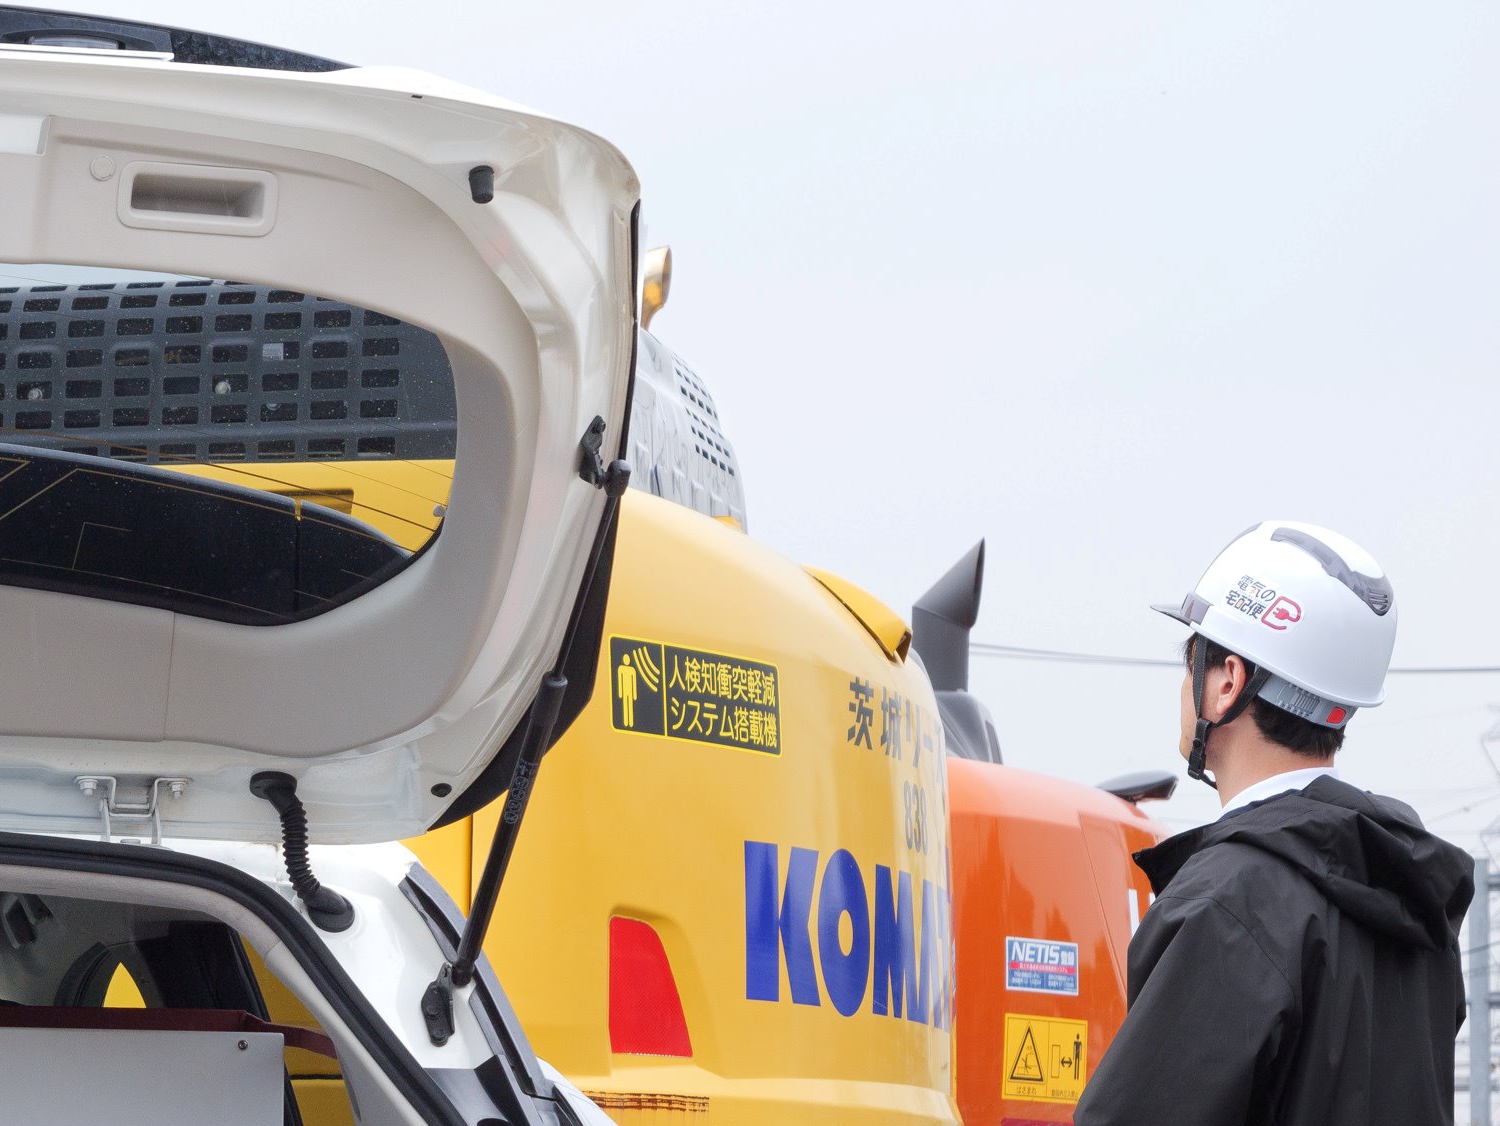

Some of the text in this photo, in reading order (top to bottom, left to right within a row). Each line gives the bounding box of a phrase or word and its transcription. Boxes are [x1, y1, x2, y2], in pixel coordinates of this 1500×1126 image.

[669, 654, 776, 708] 人検知衝突軽減
[670, 696, 778, 749] システム搭載機
[743, 839, 951, 1034] KOMAT
